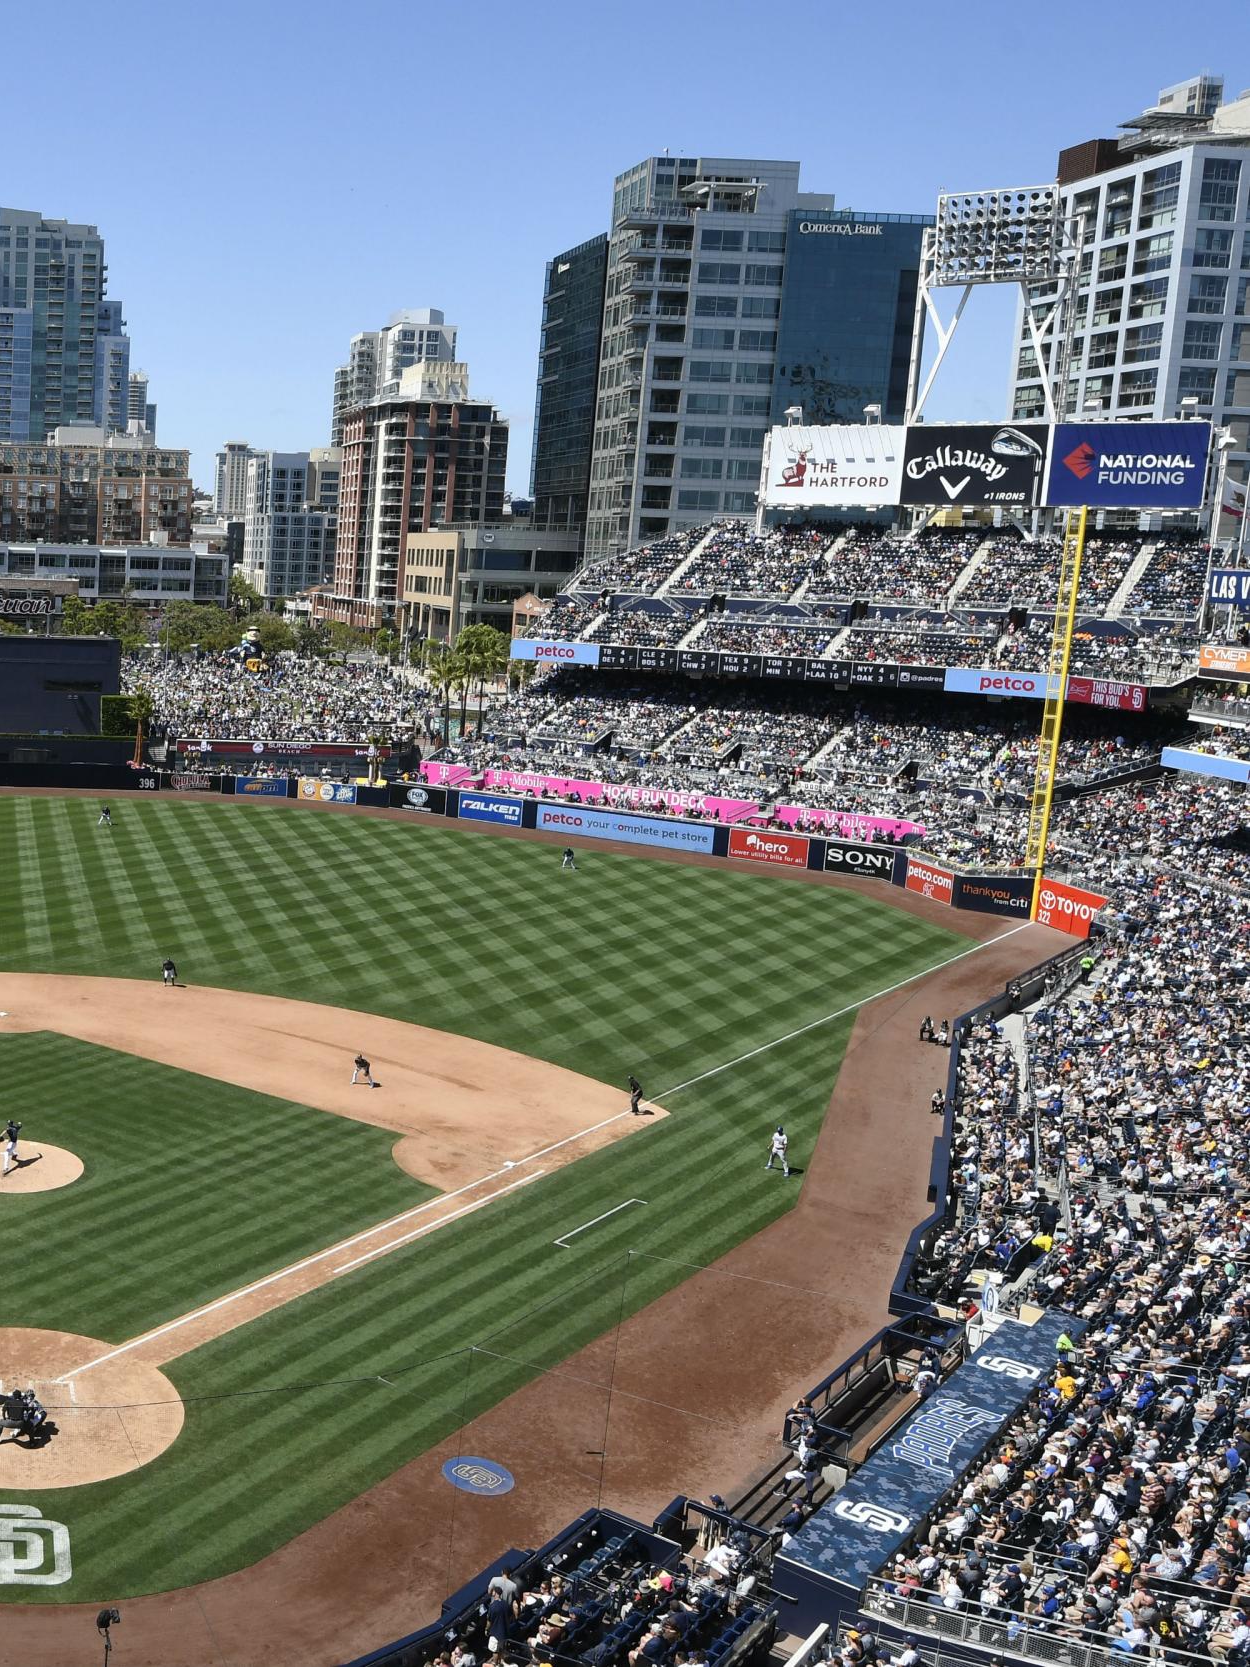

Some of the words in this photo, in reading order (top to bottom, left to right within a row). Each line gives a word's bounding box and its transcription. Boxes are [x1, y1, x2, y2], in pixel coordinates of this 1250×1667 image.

[853, 224, 883, 234] Bank
[811, 463, 837, 473] THE
[907, 445, 1006, 481] Callaway
[1100, 455, 1195, 468] NATIONAL
[810, 477, 888, 487] HARTFORD
[1098, 472, 1184, 484] FUNDING
[1212, 576, 1236, 598] LAS
[535, 646, 574, 658] petco
[1204, 648, 1247, 661] CYMER
[980, 675, 1035, 694] petco
[1093, 681, 1107, 693] THIS
[1109, 684, 1129, 696] BUD'S
[1091, 693, 1104, 704] FOR
[1106, 696, 1120, 708] YOU.
[439, 766, 450, 778] T
[139, 779, 155, 788] 396
[171, 775, 209, 791] CHOLULA
[462, 799, 520, 816] FALKEN
[642, 791, 669, 806] RUN
[671, 793, 706, 810] DECK
[543, 812, 583, 827] petco
[587, 819, 609, 830] your
[612, 822, 659, 837] complete
[662, 829, 679, 839] pet
[682, 832, 708, 843] store
[756, 838, 788, 854] hero
[751, 850, 768, 859] utility
[827, 848, 893, 870] SONY
[908, 865, 952, 889] petco.com
[962, 884, 1010, 899] thankyou
[1010, 896, 1028, 908] citi
[1057, 896, 1098, 921] TOYOT
[1038, 910, 1050, 924] 322
[892, 1399, 1006, 1477] PADRES
